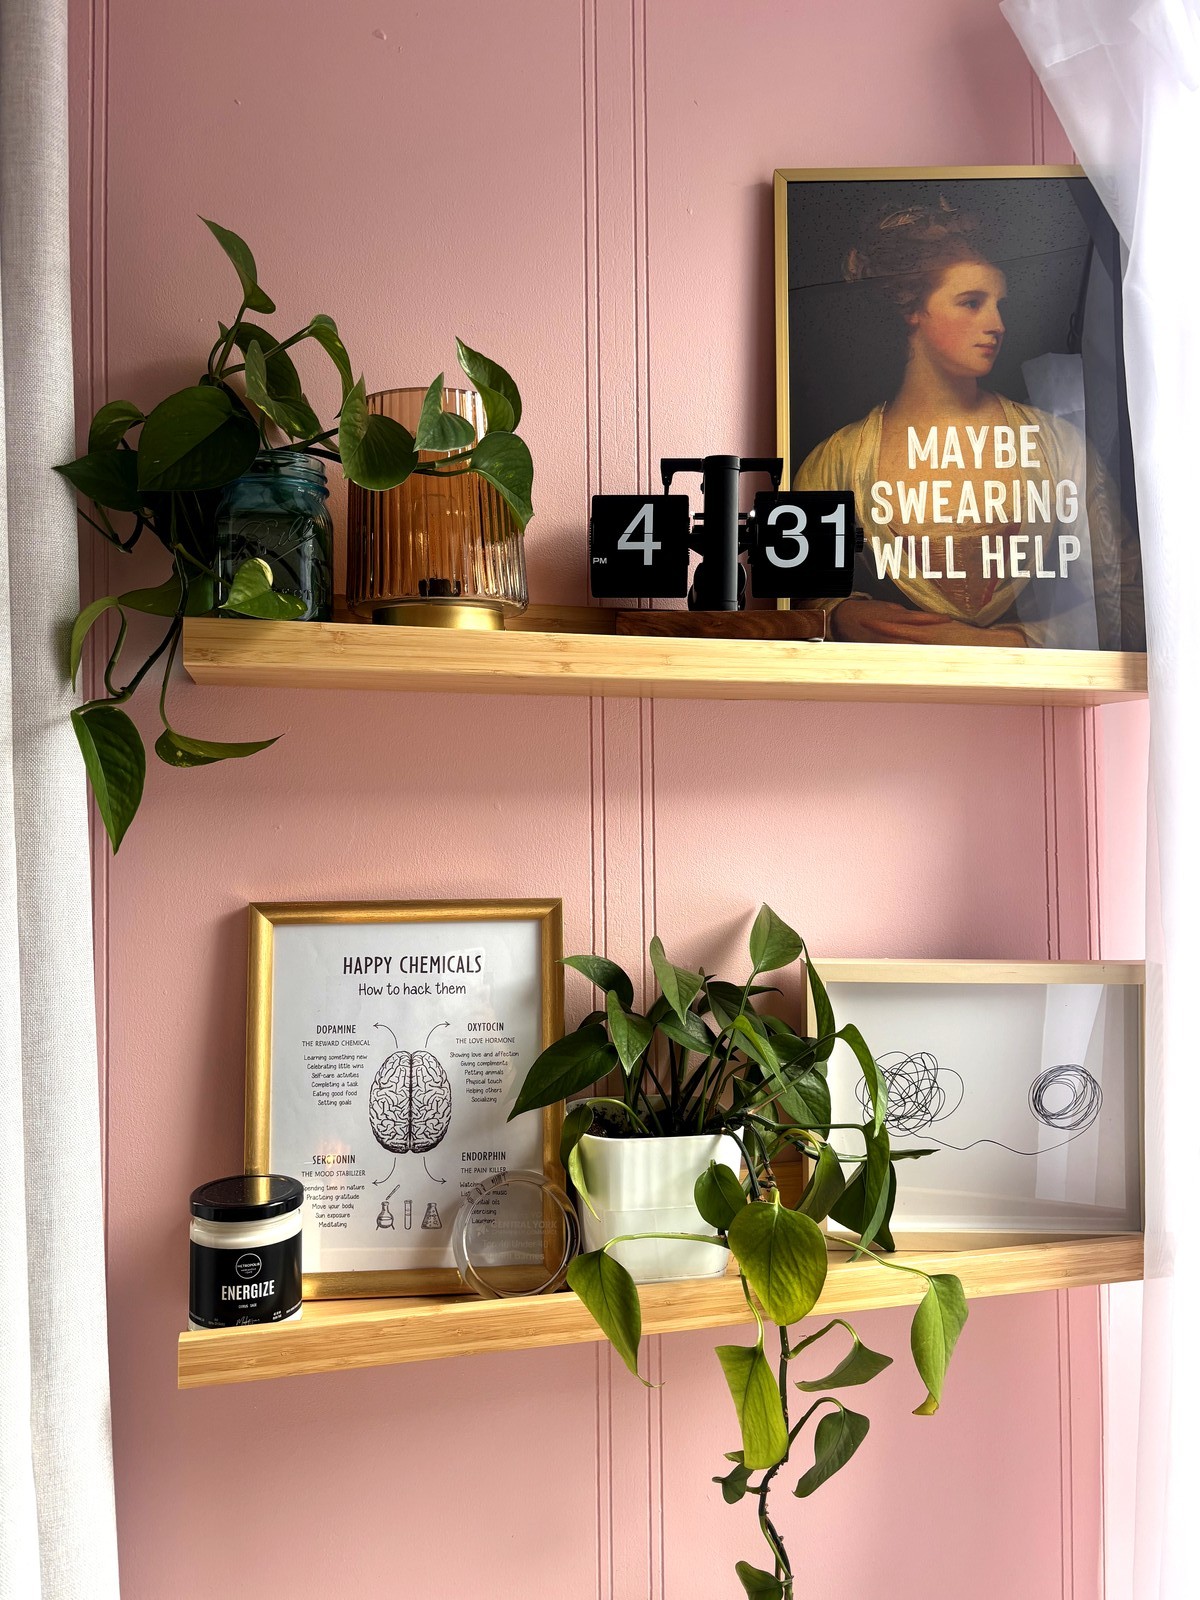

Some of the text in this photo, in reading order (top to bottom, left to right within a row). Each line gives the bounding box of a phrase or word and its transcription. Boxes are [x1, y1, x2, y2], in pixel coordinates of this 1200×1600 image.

[907, 424, 1041, 470] MAYBE
[870, 479, 1079, 525] SWEARING
[617, 503, 845, 569] 4 31
[592, 557, 608, 565] PM
[871, 534, 1081, 580] WILL HELP
[343, 955, 482, 975] HAPPY CHEMICALS
[358, 982, 467, 996] How to hack them
[316, 1024, 356, 1035] DOPAMINE
[467, 1022, 504, 1032] OXYTOCIN
[341, 1039, 371, 1047] CHEMICAL
[449, 1051, 470, 1059] Showing
[461, 1151, 506, 1161] ENDORPHIN
[303, 1184, 325, 1193] pending
[490, 1220, 558, 1229] CENTRAL YORK
[221, 1279, 275, 1301] ENERGIZE
